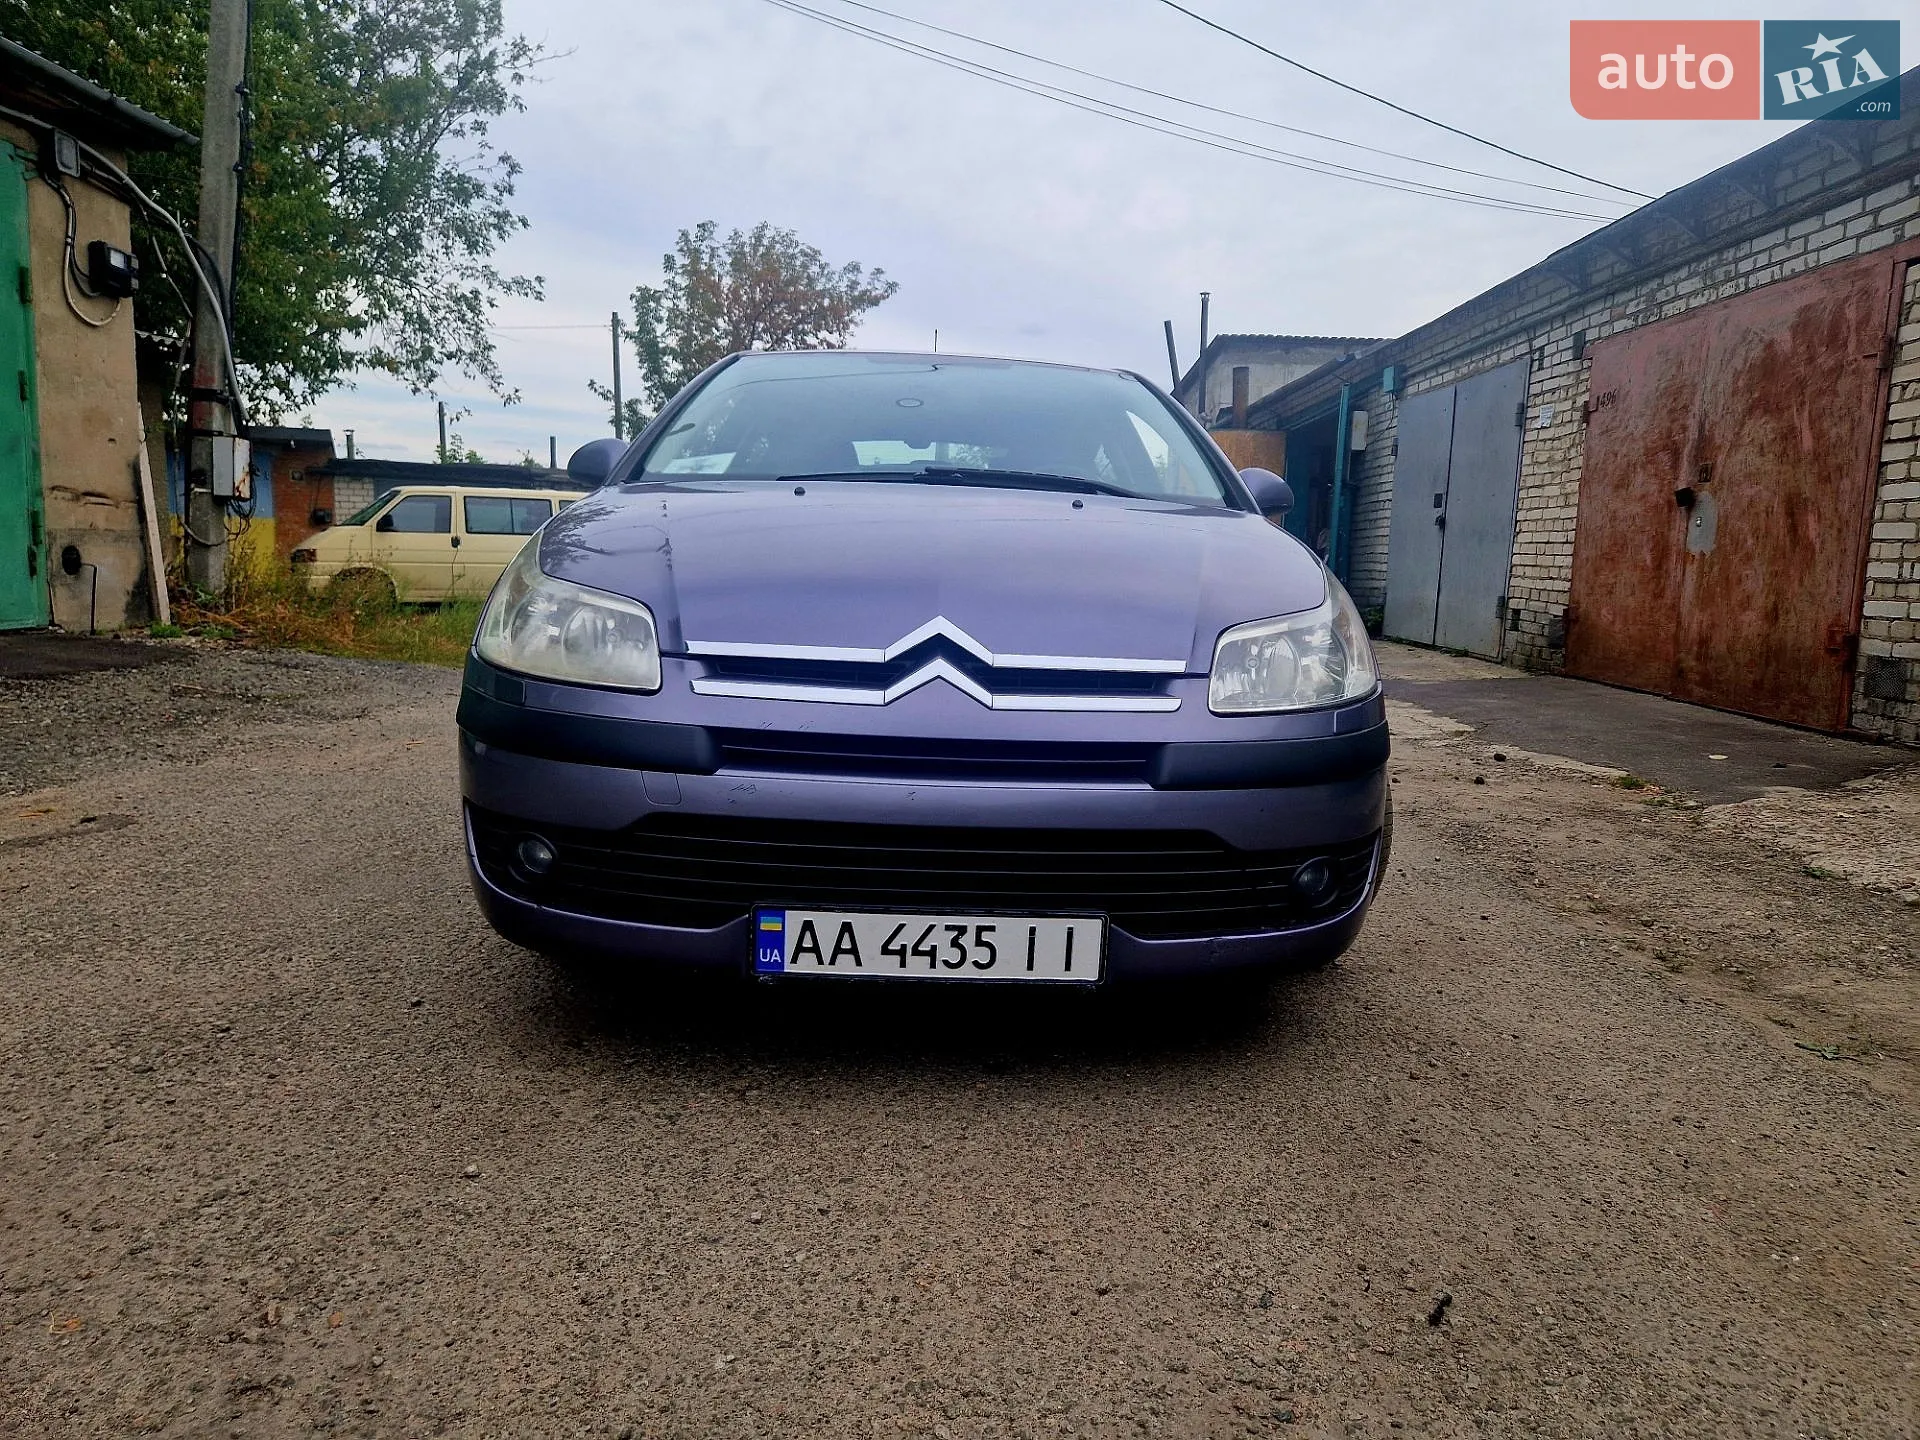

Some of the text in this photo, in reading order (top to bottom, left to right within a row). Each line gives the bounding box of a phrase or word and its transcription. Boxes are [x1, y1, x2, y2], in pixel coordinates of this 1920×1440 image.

[760, 948, 782, 963] UA
[790, 919, 863, 967] AA
[880, 922, 997, 970] 4435
